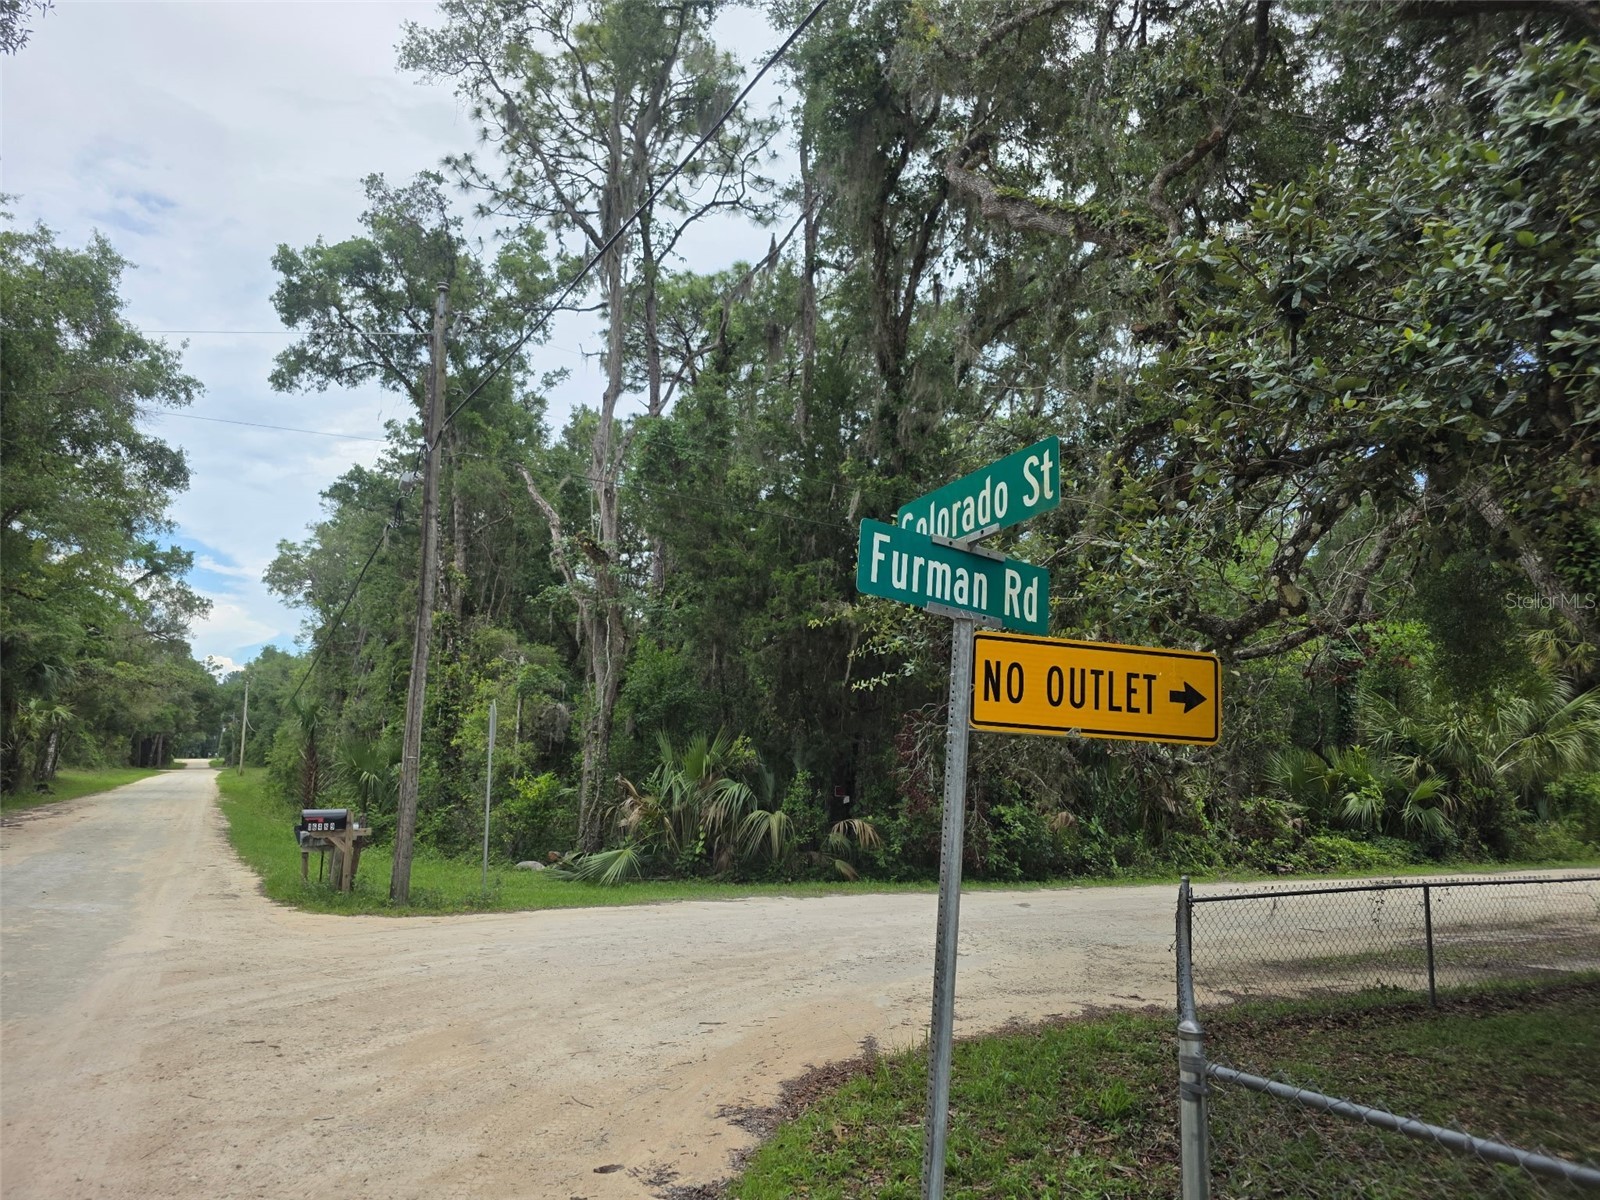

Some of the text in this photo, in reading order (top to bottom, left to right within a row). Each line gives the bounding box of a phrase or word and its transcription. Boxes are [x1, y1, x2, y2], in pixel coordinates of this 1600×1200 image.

[1022, 449, 1054, 507] St
[870, 532, 1039, 623] Furman Rd
[983, 659, 1157, 715] NO OUTLET
